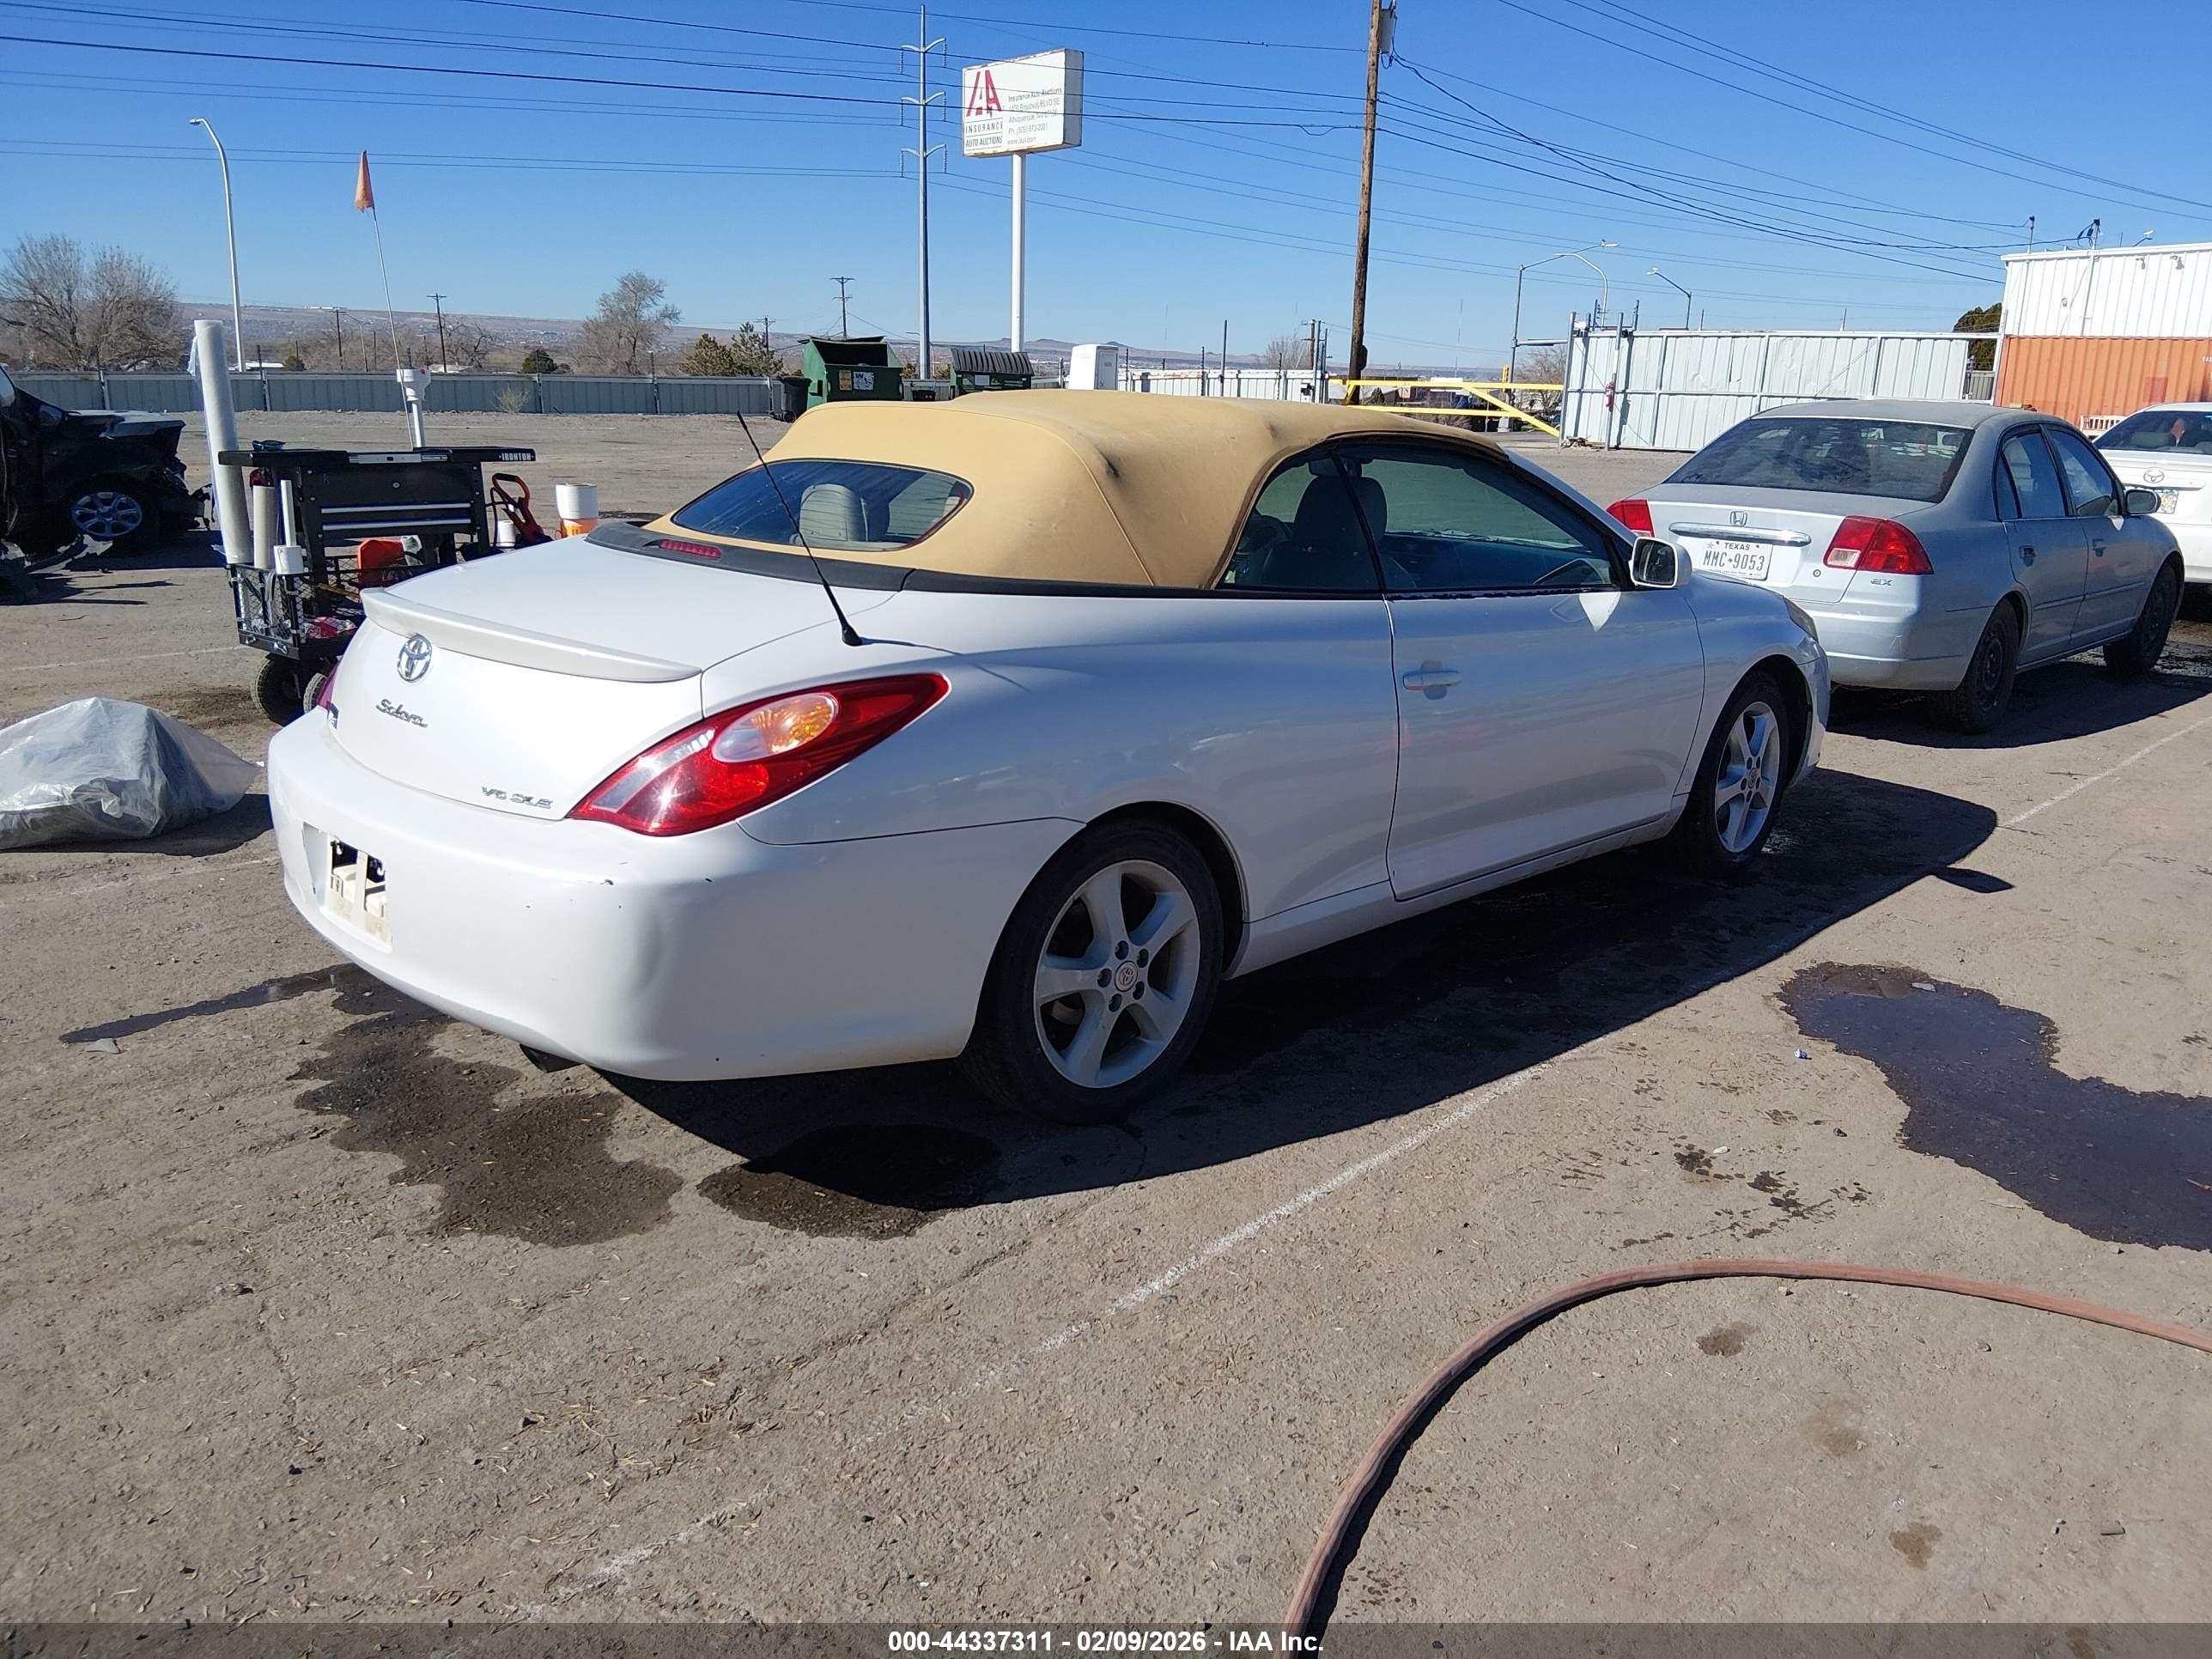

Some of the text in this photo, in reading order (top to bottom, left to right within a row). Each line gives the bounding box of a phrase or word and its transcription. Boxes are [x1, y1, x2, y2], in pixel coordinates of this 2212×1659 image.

[1008, 93, 1030, 103] Insurance
[1042, 88, 1063, 96] Auctions
[965, 121, 1003, 134] INSURANCE
[965, 135, 1003, 148] AUTO AUCTIONS
[501, 453, 532, 461] IRONTON
[1724, 542, 1751, 551] TEXAS
[1870, 578, 1893, 586] EX
[375, 698, 428, 728] Solara
[482, 786, 554, 810] V6 SLE
